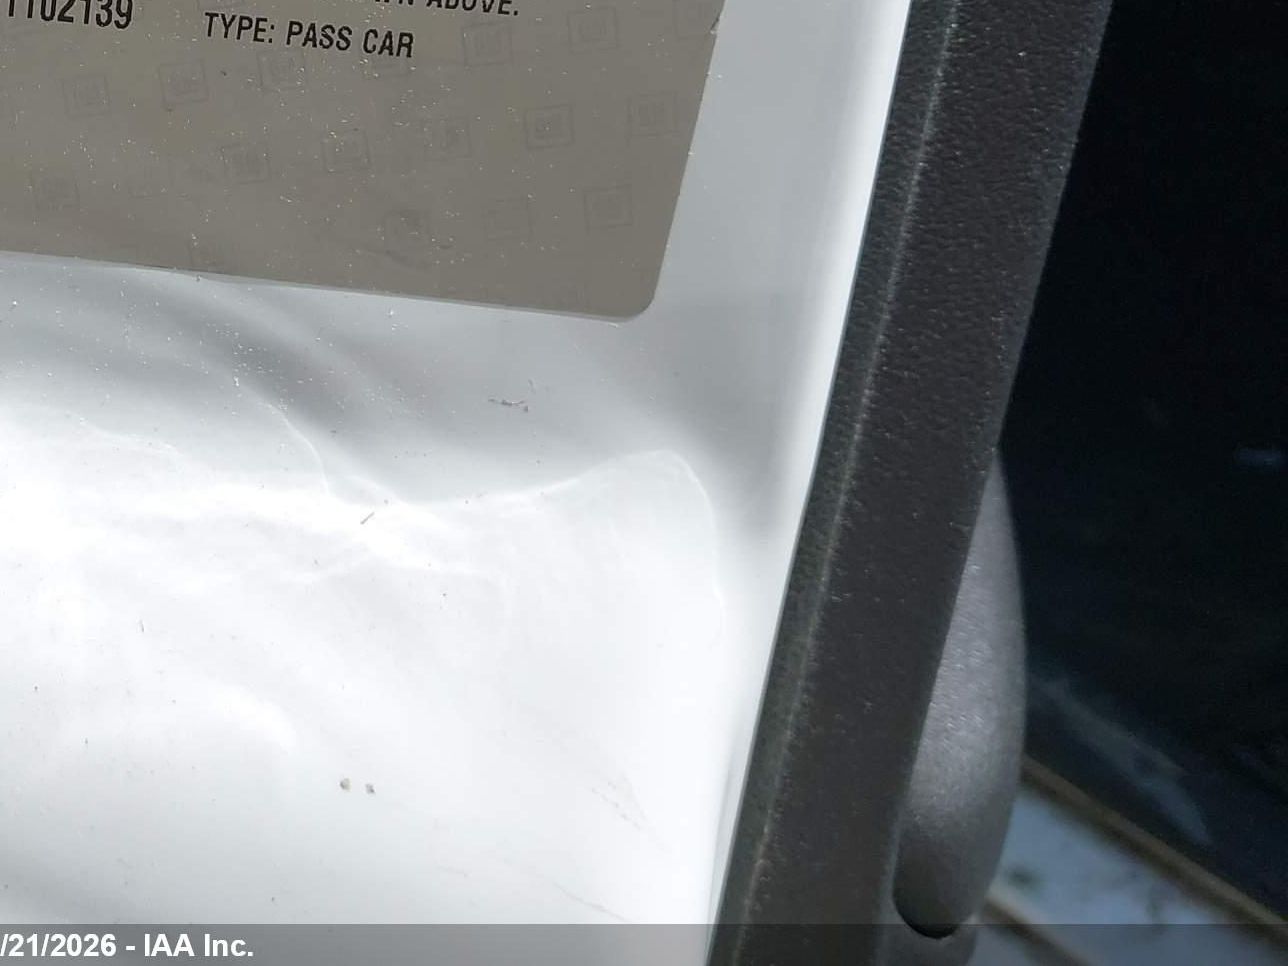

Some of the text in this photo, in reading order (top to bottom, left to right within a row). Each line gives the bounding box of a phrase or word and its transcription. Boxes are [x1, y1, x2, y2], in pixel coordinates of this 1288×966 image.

[205, 12, 415, 59] TYPE: PASS CAR
